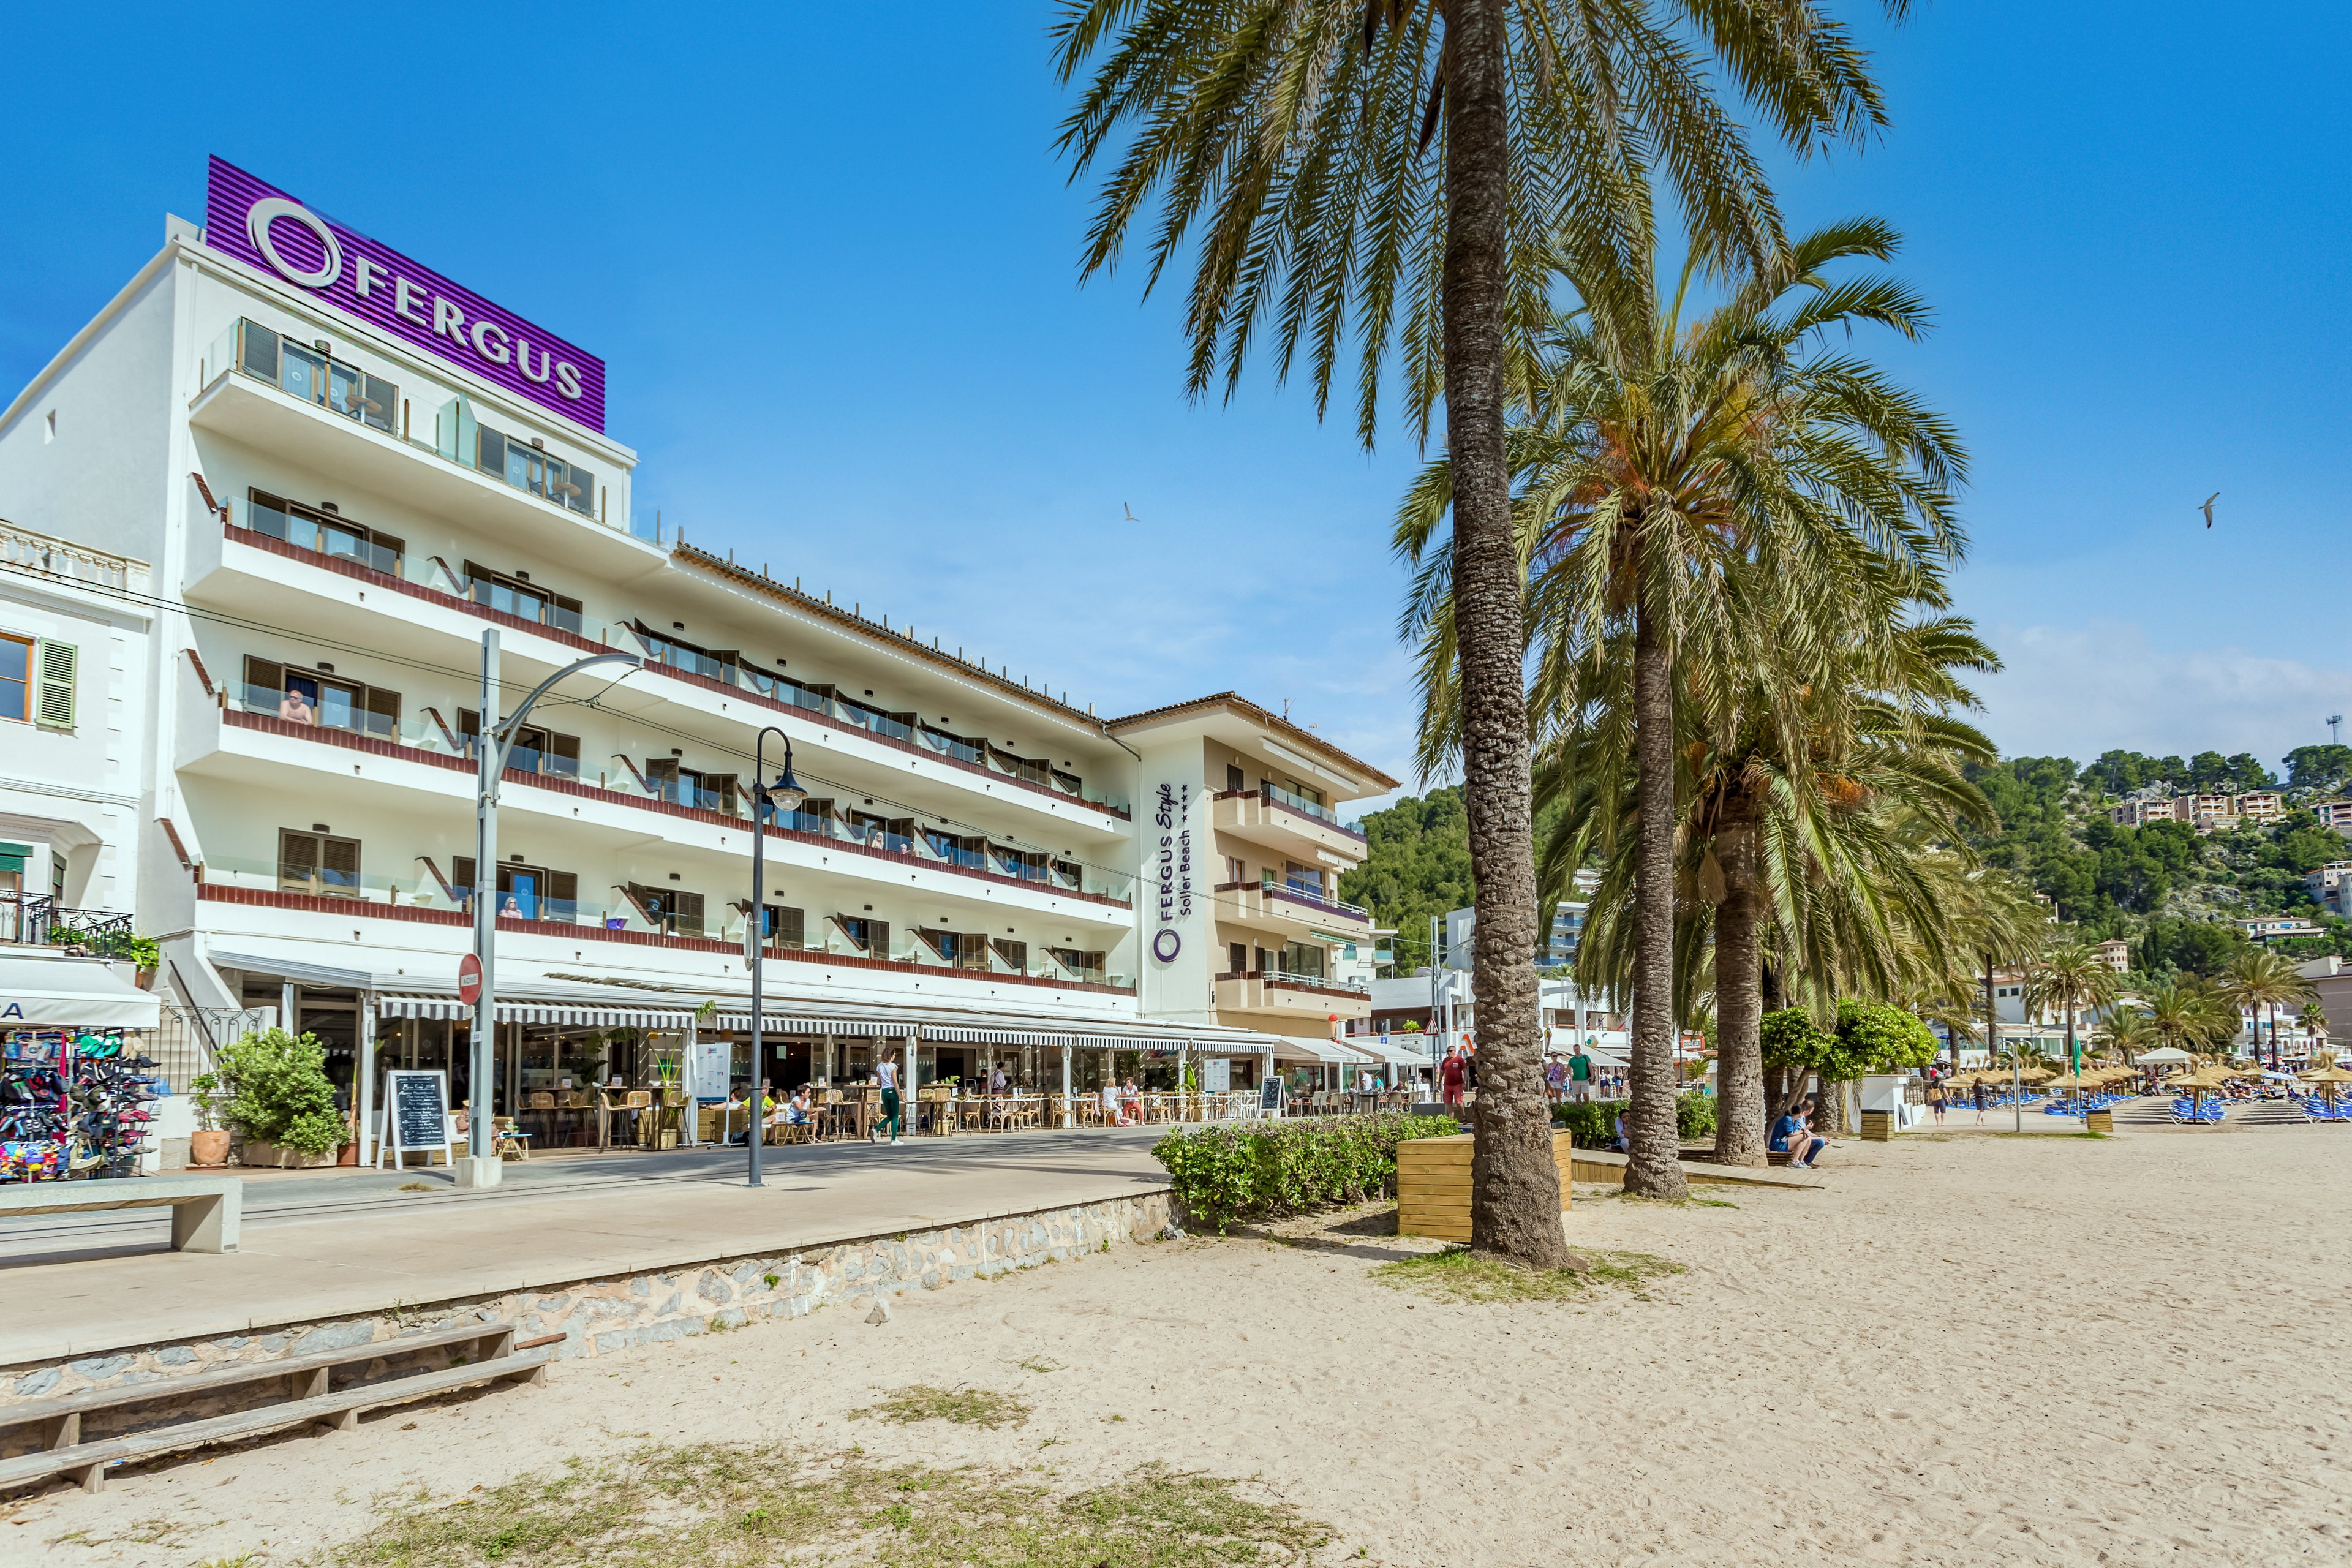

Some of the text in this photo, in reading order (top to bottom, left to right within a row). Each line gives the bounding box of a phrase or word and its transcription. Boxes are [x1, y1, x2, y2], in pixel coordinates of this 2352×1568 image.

[355, 255, 583, 399] FERGUS
[1156, 783, 1178, 921] FERGUS Style
[1179, 830, 1191, 916] Soller Beach
